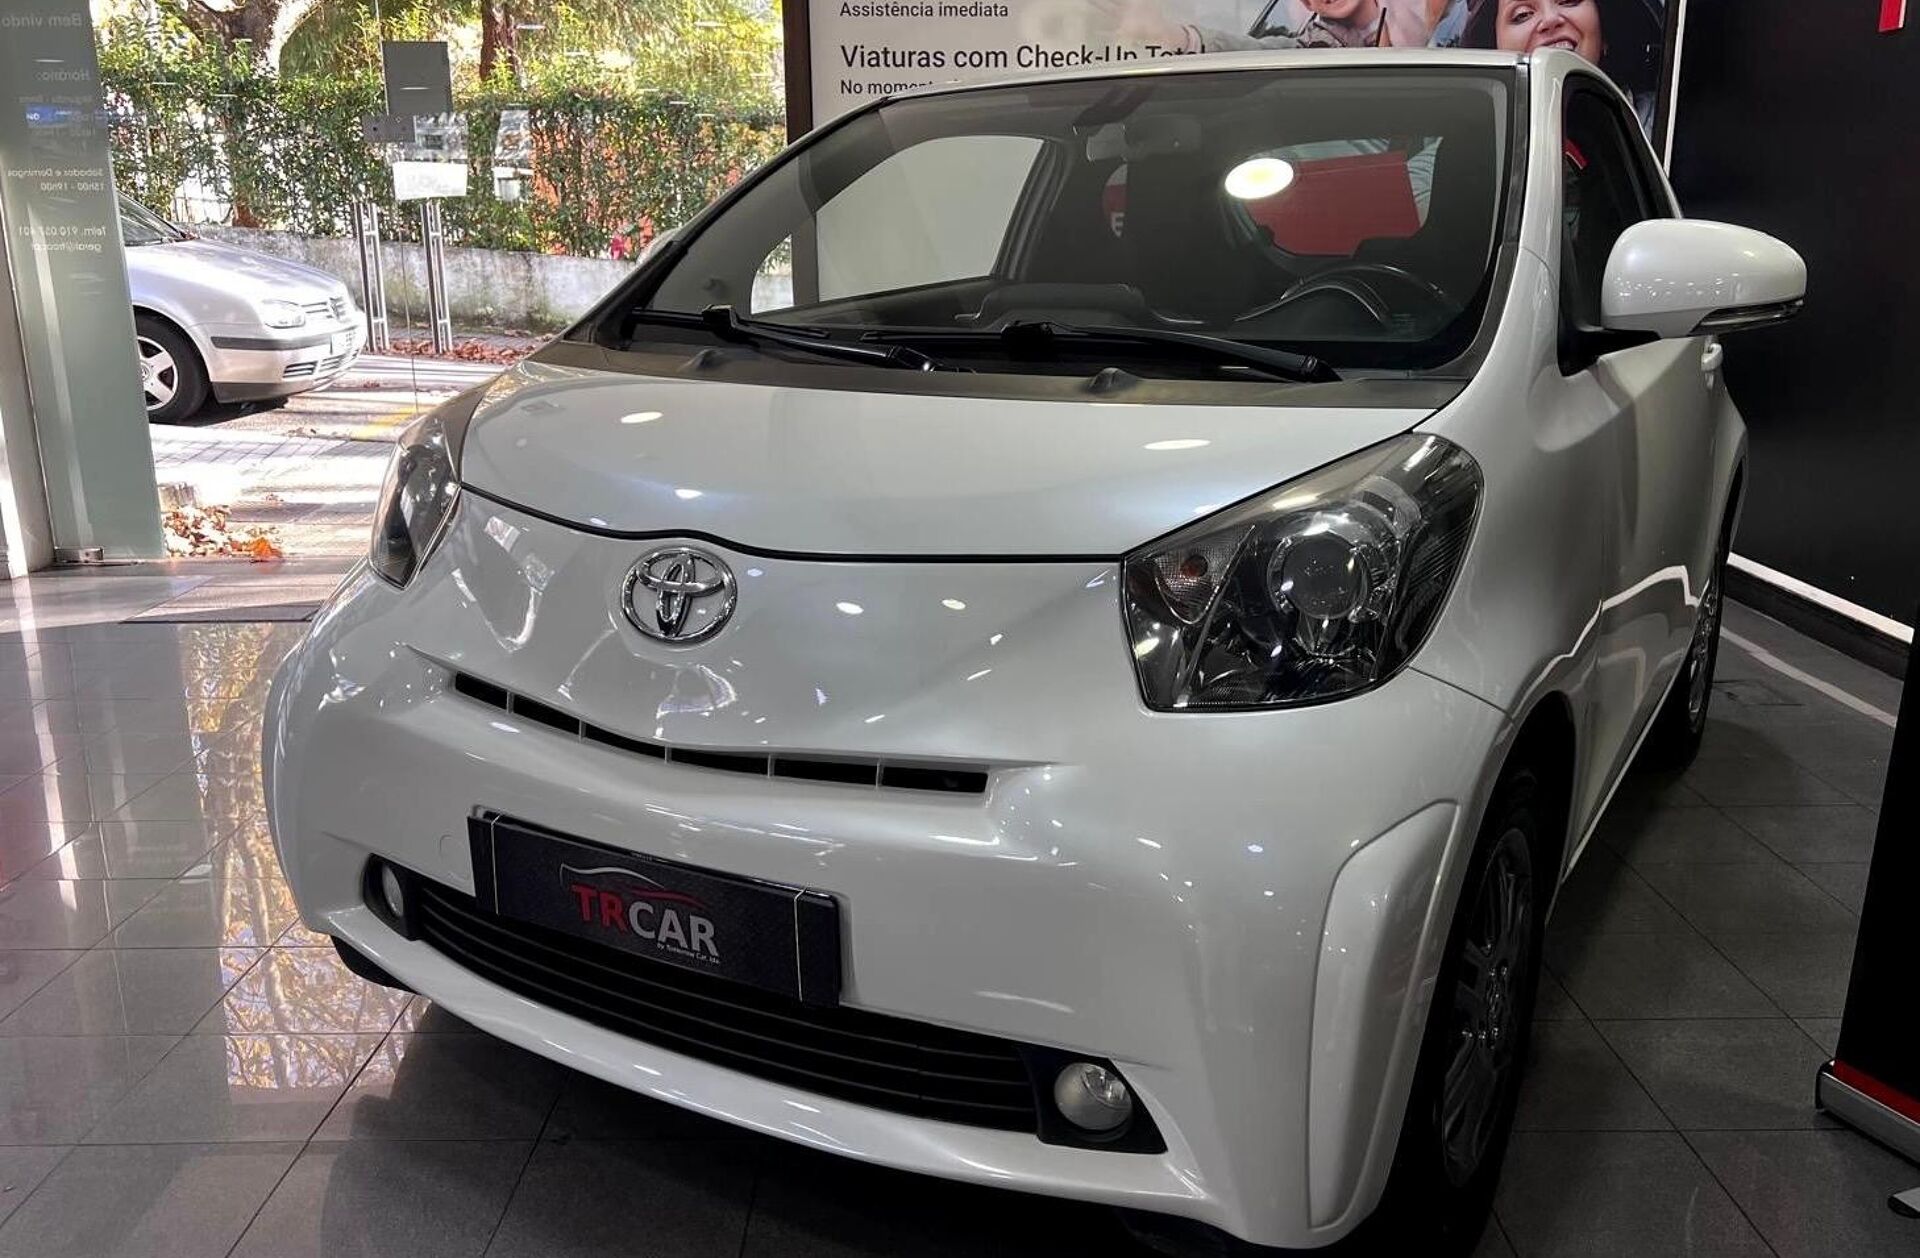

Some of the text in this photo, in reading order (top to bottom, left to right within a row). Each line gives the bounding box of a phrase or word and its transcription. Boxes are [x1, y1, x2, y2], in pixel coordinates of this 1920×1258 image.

[839, 1, 1008, 18] Assistência imediata
[840, 45, 945, 68] Viaturas
[954, 49, 1008, 68] com
[840, 80, 863, 94] No
[570, 883, 719, 957] TRCAR
